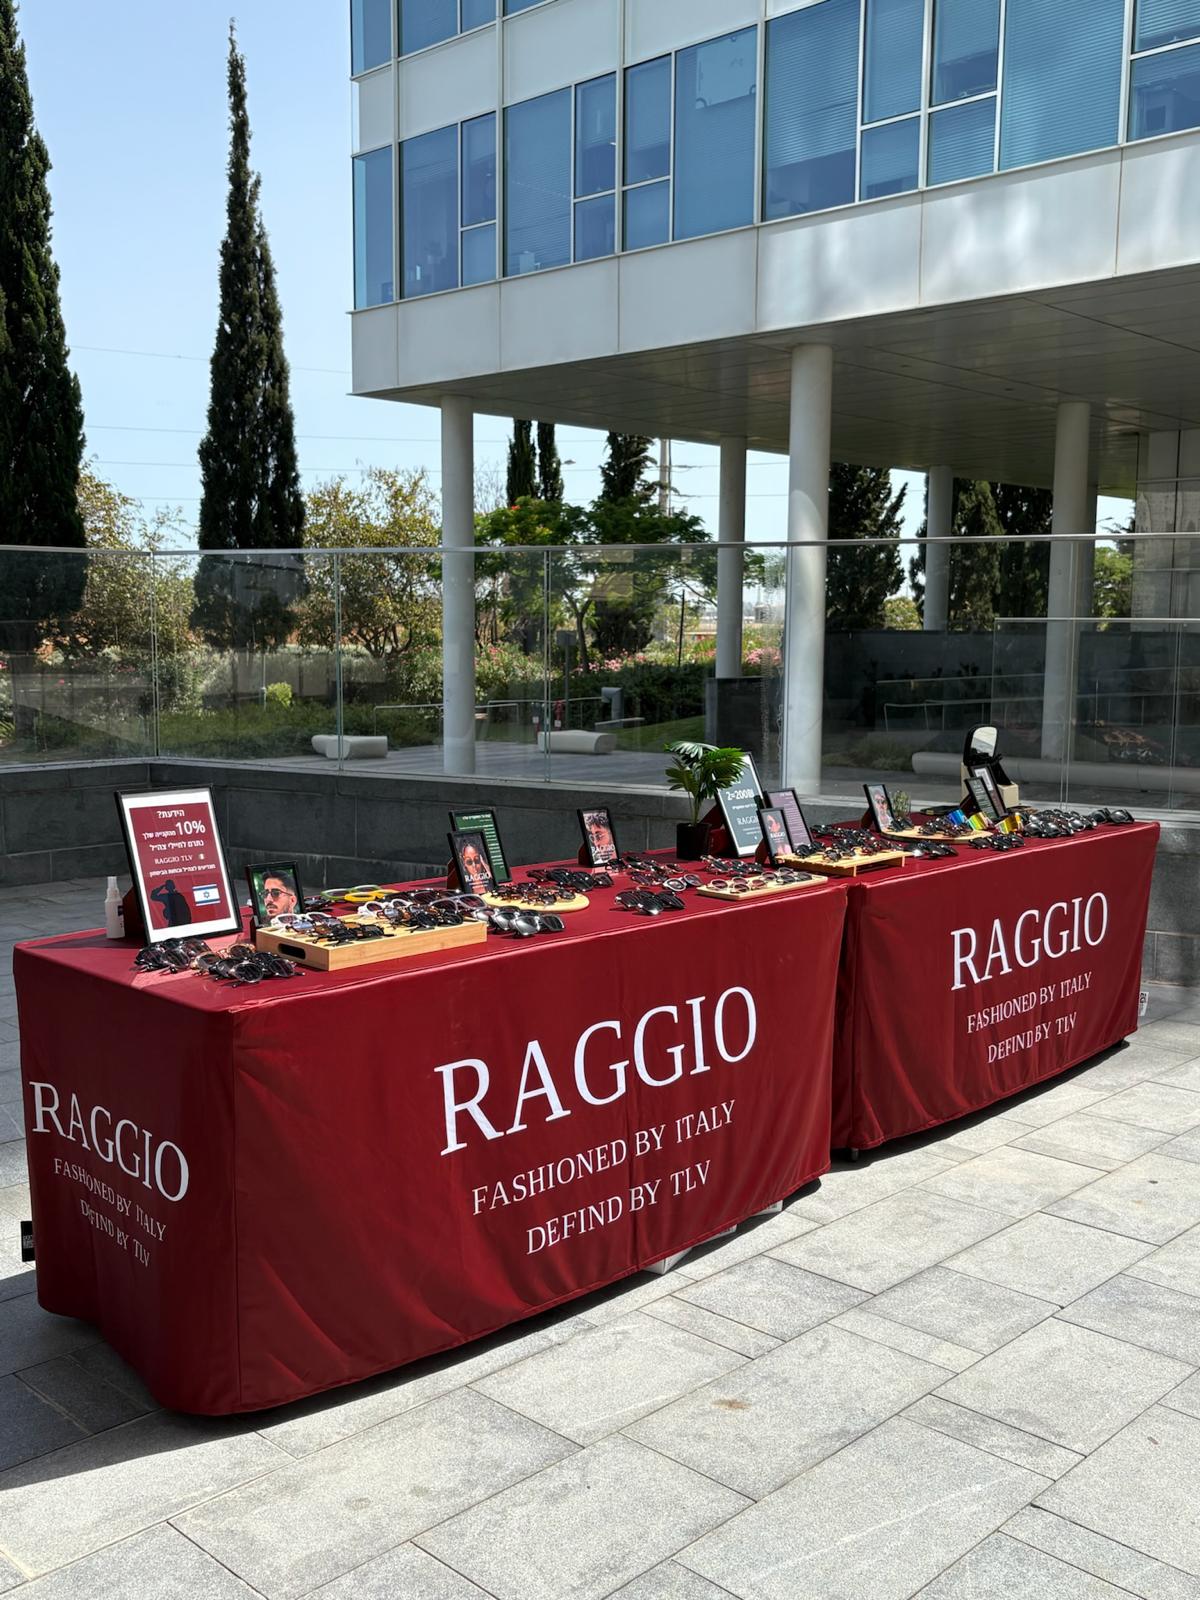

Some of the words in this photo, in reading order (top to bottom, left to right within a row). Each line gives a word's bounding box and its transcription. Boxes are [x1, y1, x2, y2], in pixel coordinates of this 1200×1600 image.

[142, 832, 154, 840] שלך
[157, 809, 185, 818] הידעת?
[176, 820, 206, 835] 10%
[154, 856, 179, 864] RAGGIO
[950, 892, 1108, 991] RAGGIO
[967, 992, 1037, 1034] FASHIONED
[1040, 984, 1056, 1005] BY
[1060, 971, 1092, 999] ITALY
[988, 1030, 1033, 1064] DEFIND
[1035, 1021, 1051, 1043] BY
[1056, 1012, 1077, 1035] TLV
[434, 986, 757, 1156] RAGGIO
[29, 1081, 190, 1202] RAGGIO
[472, 1138, 627, 1216] FASHIONED
[634, 1124, 666, 1157] BY
[675, 1099, 735, 1143] ITALY
[116, 1193, 132, 1217] BY
[136, 1204, 167, 1242] ITALY
[526, 1195, 623, 1255] DEFIND
[629, 1179, 662, 1212] BY
[670, 1159, 711, 1196] TLV
[117, 1227, 129, 1250] BY
[133, 1238, 150, 1267] TLV
